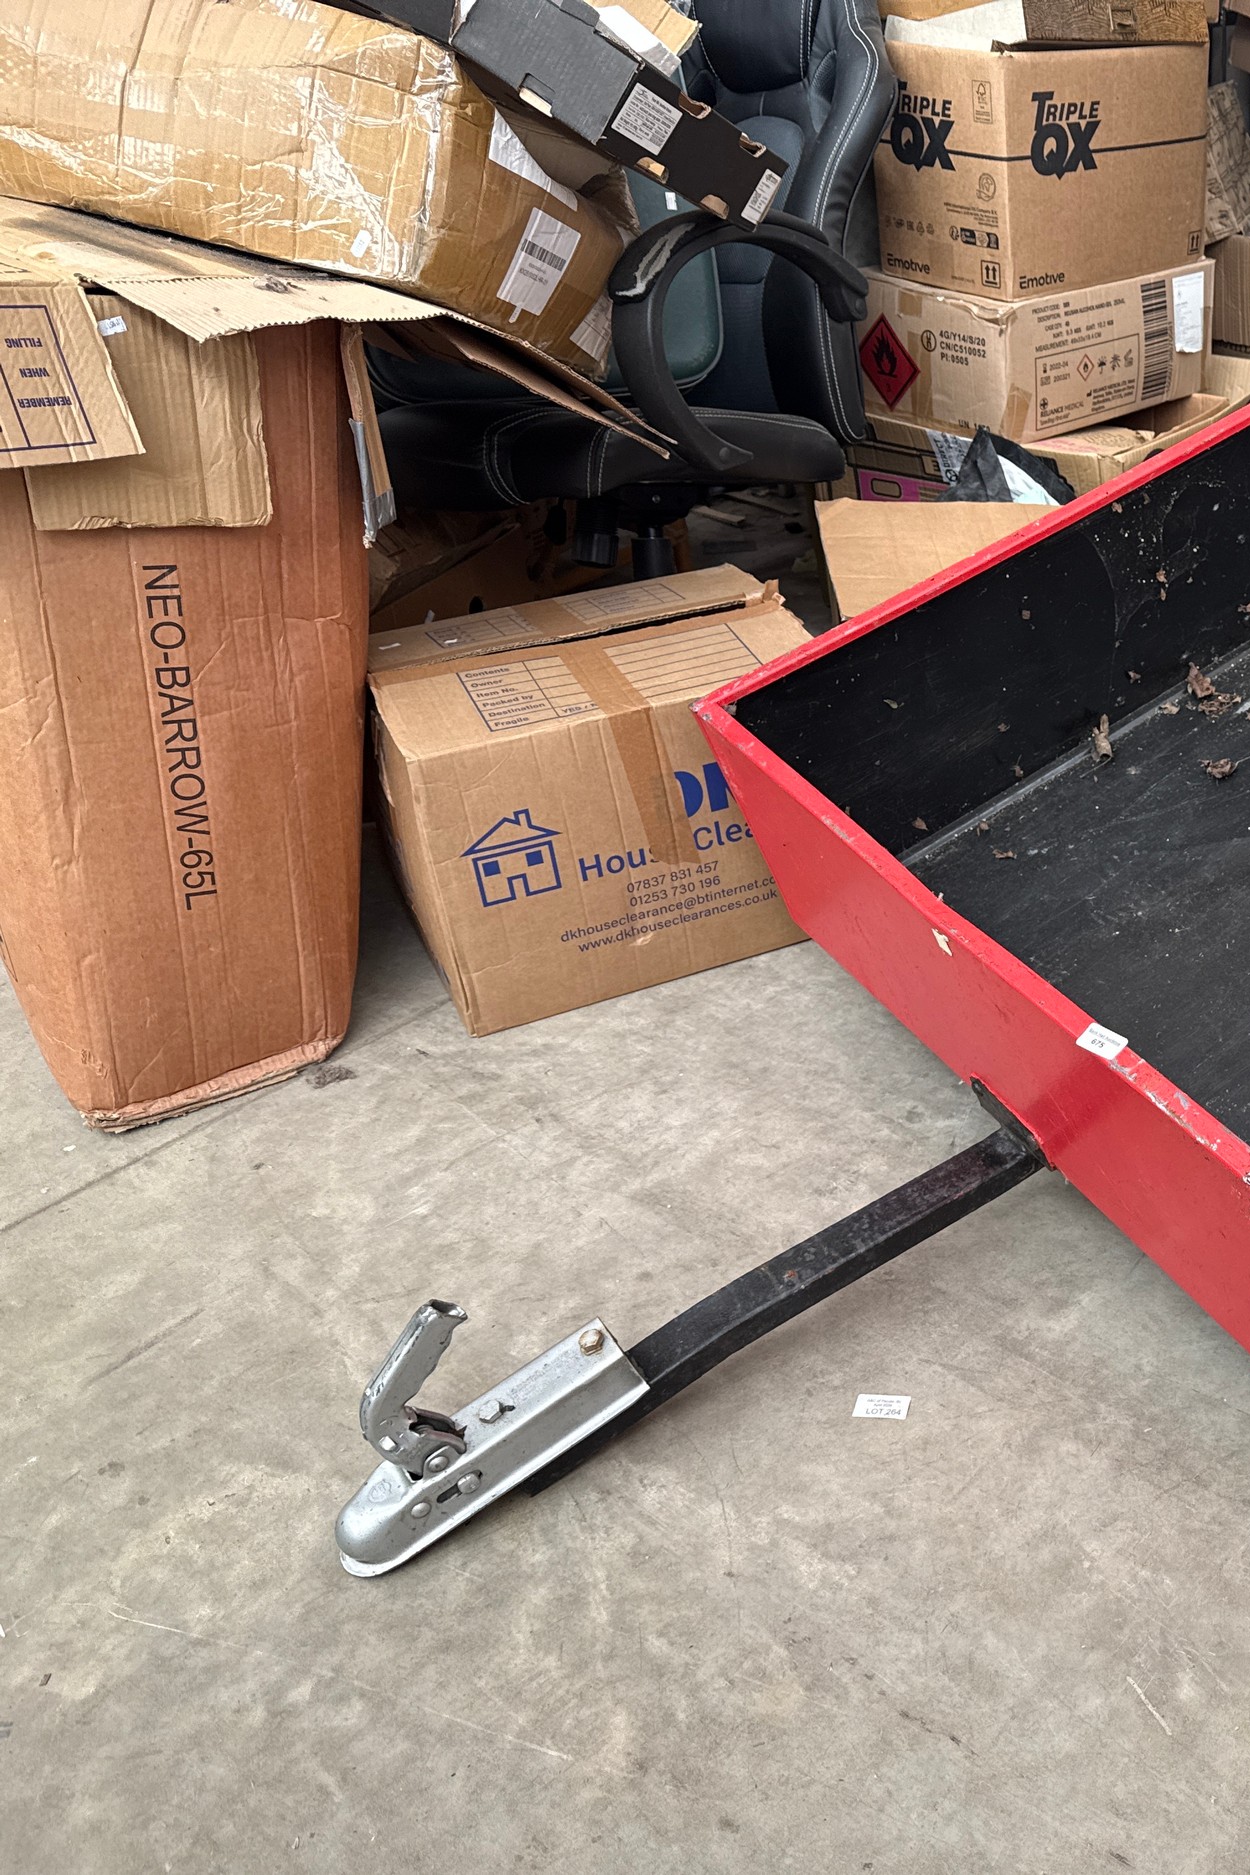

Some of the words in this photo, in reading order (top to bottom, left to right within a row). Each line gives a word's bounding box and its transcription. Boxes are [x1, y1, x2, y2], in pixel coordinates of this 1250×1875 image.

[1031, 91, 1100, 131] TRIPLE
[891, 113, 956, 172] QX
[1031, 120, 1101, 180] QX
[887, 253, 930, 275] Emotive
[1019, 272, 1065, 290] Emotive
[4, 338, 43, 348] FILLING
[939, 330, 986, 347] 4G/Y14/S/20
[19, 368, 50, 378] WHEN
[17, 396, 73, 409] REMEMBER
[465, 667, 510, 679] Contents
[470, 680, 503, 688] Owner
[476, 690, 499, 698] Item
[482, 697, 519, 708] Packed
[521, 694, 534, 702] by
[488, 703, 546, 718] Destination
[494, 716, 529, 728] Fragile
[142, 564, 218, 911] NEO-BARROW-65L
[626, 874, 666, 894] 07837
[669, 867, 693, 883] 831
[695, 860, 720, 877] 457
[629, 889, 669, 908] 01253
[671, 881, 696, 897] 730
[699, 875, 721, 890] 196
[578, 888, 778, 952] www.dkhouseclearances.co.uk
[1091, 1038, 1105, 1048] 675
[884, 1408, 902, 1416] 264
